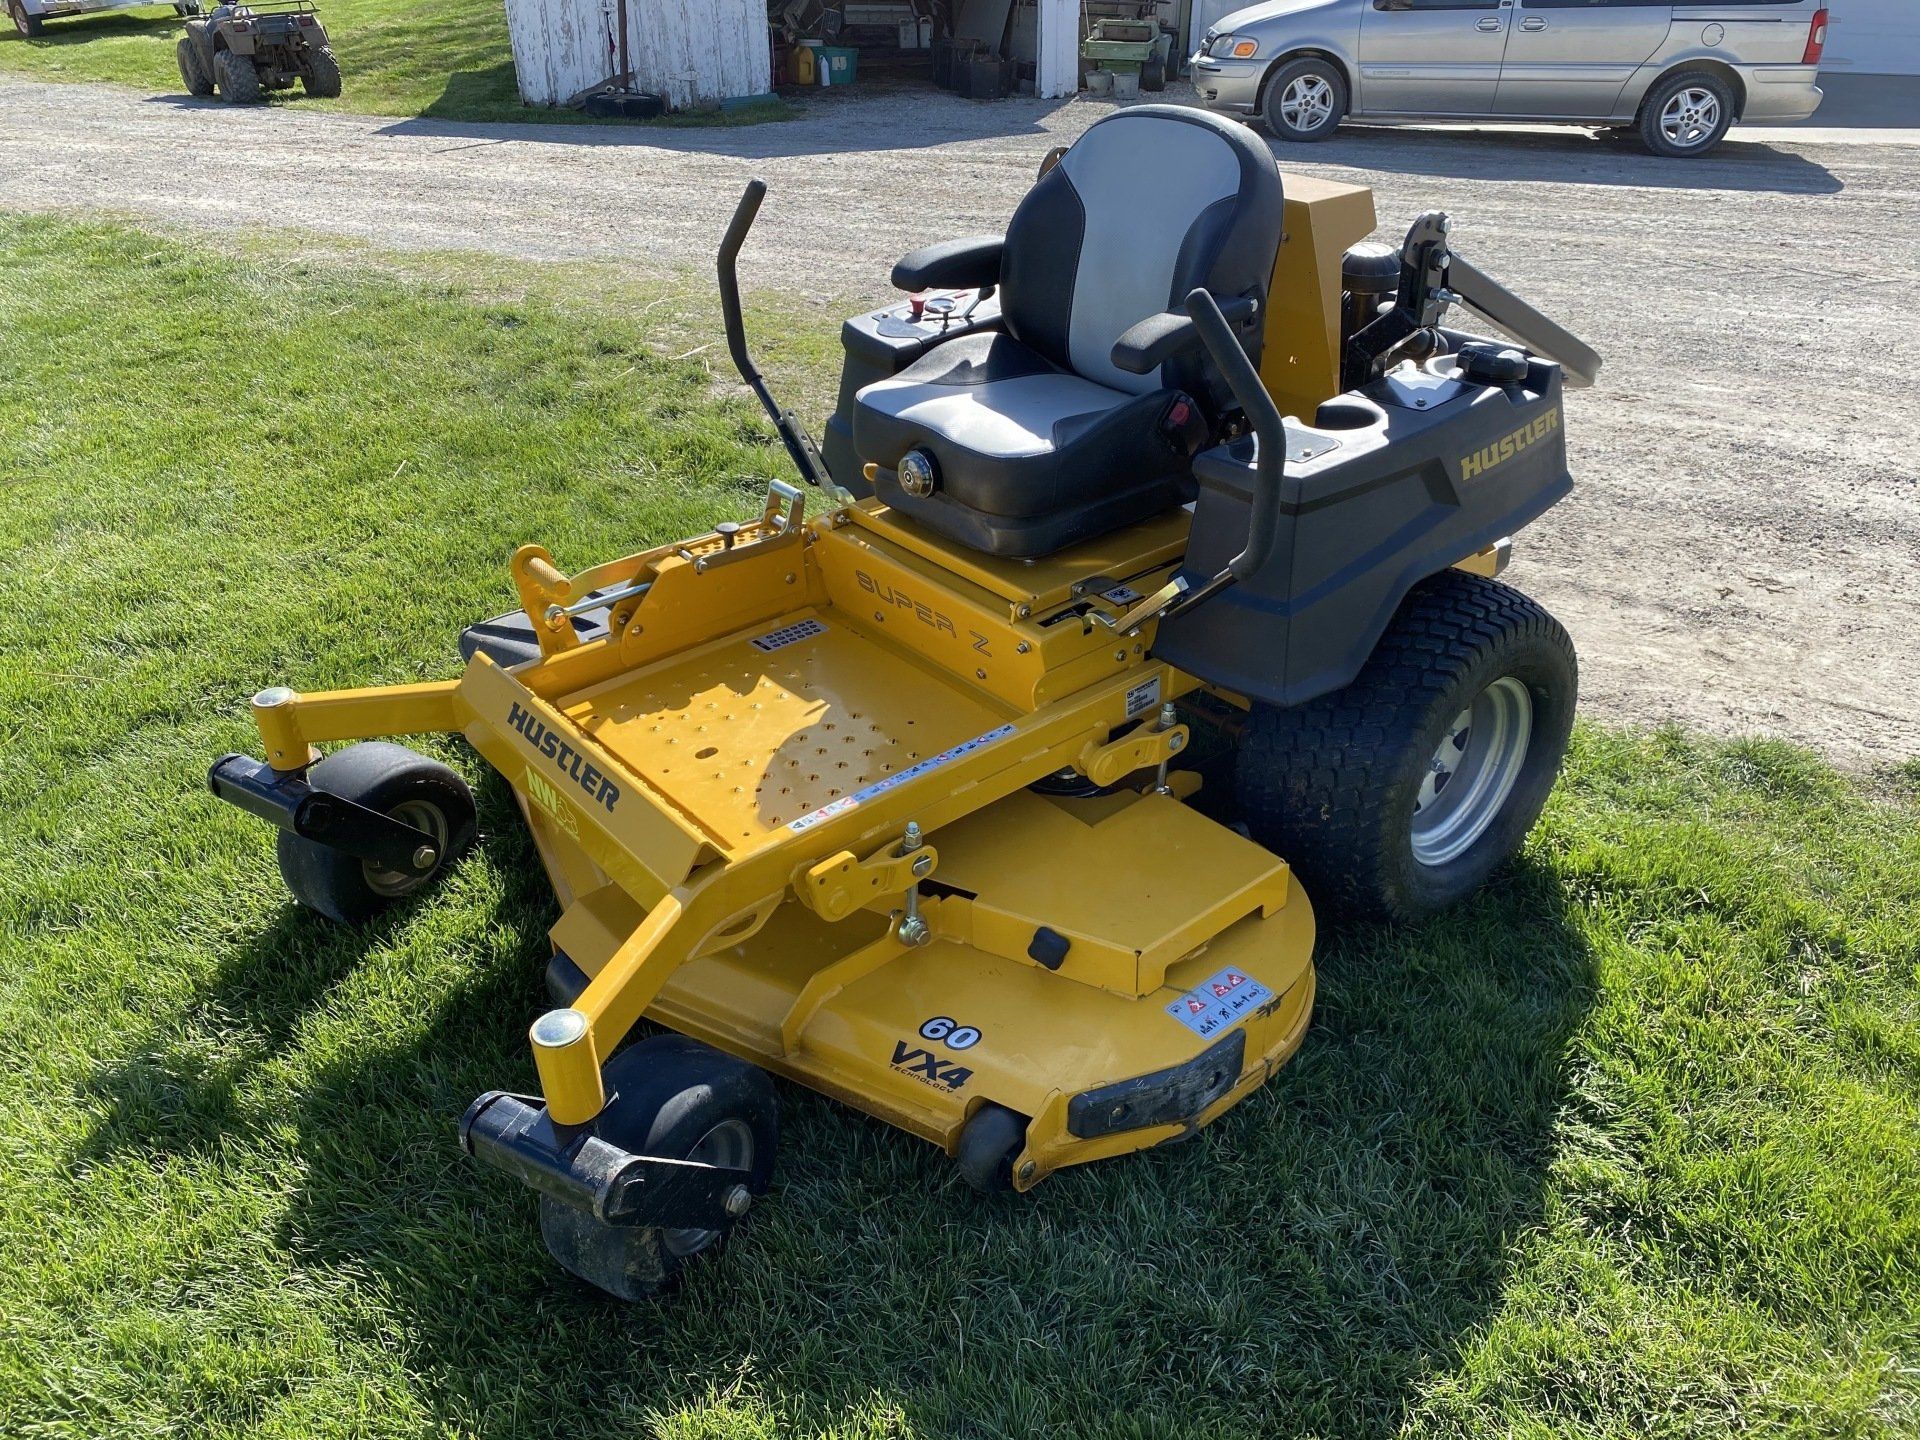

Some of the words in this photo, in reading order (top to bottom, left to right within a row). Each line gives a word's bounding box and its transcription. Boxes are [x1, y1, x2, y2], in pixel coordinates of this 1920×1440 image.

[1461, 407, 1557, 481] HUSTLER
[856, 569, 957, 639] SUPER
[969, 629, 993, 658] Z
[507, 701, 620, 813] HUSTLER
[525, 764, 557, 815] NW
[919, 1016, 982, 1050] 60
[889, 1064, 954, 1094] TECHNOLOGY
[891, 1040, 974, 1090] VX4
